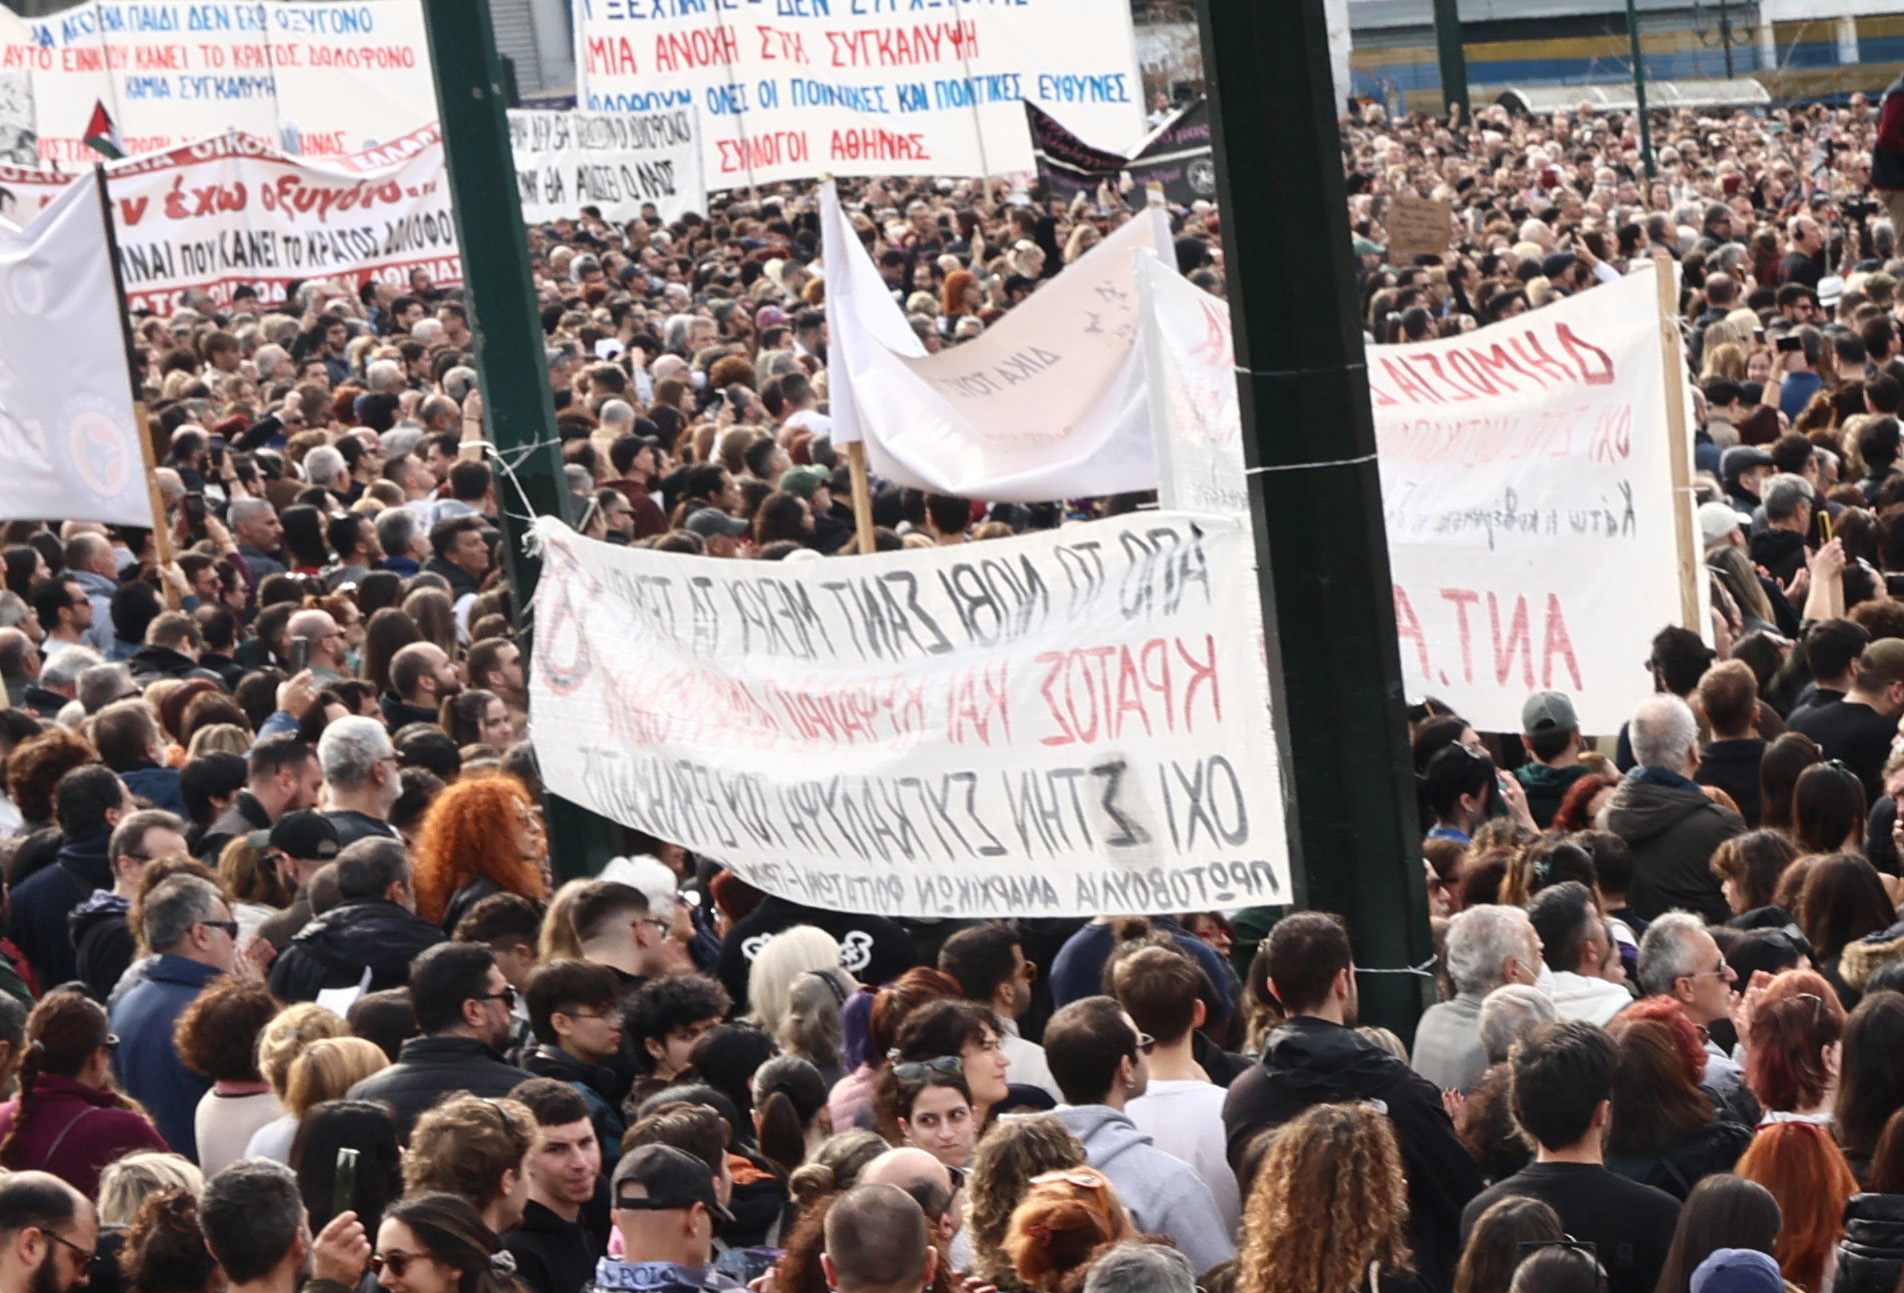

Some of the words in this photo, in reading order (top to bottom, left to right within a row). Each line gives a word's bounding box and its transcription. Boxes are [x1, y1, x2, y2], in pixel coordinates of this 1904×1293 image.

[129, 5, 179, 31] ΠΑΙΔΙ
[188, 5, 230, 31] ΔΕΝ
[275, 7, 374, 34] ΟΞΥΓΟΝΟ
[3, 45, 52, 71] ΑΥΤΟ
[199, 45, 224, 69] ΤΟ
[231, 44, 303, 68] ΚΡΑΤΟΣ
[308, 46, 416, 69] ΔΟΛΟΦΟΝΟ
[655, 24, 740, 73] ΑΝΟΧΗ
[825, 19, 979, 68] ΣΥΓΚΑΛΥΨΗ
[758, 80, 777, 109] ΟΙ
[1039, 73, 1131, 103] ΕΥΘΥΝΕΣ
[830, 128, 931, 160] ΑΘΗΝΑΣ
[165, 174, 247, 220] έχω
[119, 240, 175, 283] ΙΝΑΙ
[306, 226, 379, 267] ΚΡΑΤΟΣ
